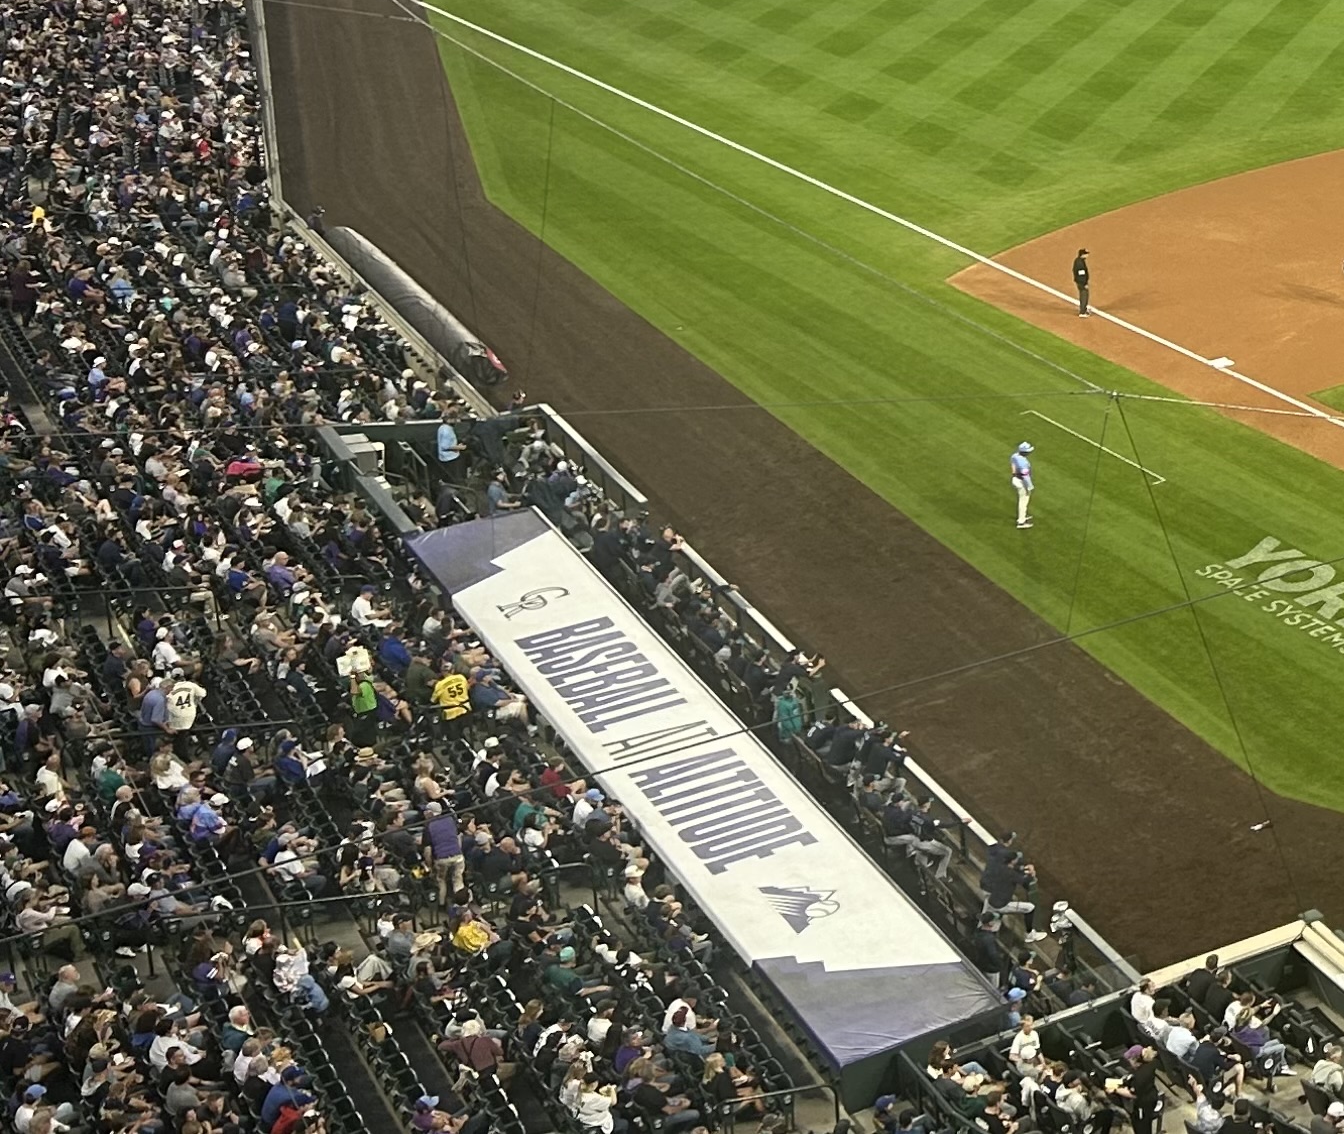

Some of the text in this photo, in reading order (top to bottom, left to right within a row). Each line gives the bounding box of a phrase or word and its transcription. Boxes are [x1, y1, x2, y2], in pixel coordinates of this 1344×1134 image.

[1195, 564, 1270, 602] SPACE
[175, 693, 192, 708] 44
[447, 685, 464, 698] 55
[513, 615, 818, 876] BASEBALL AT ALTITUDE
